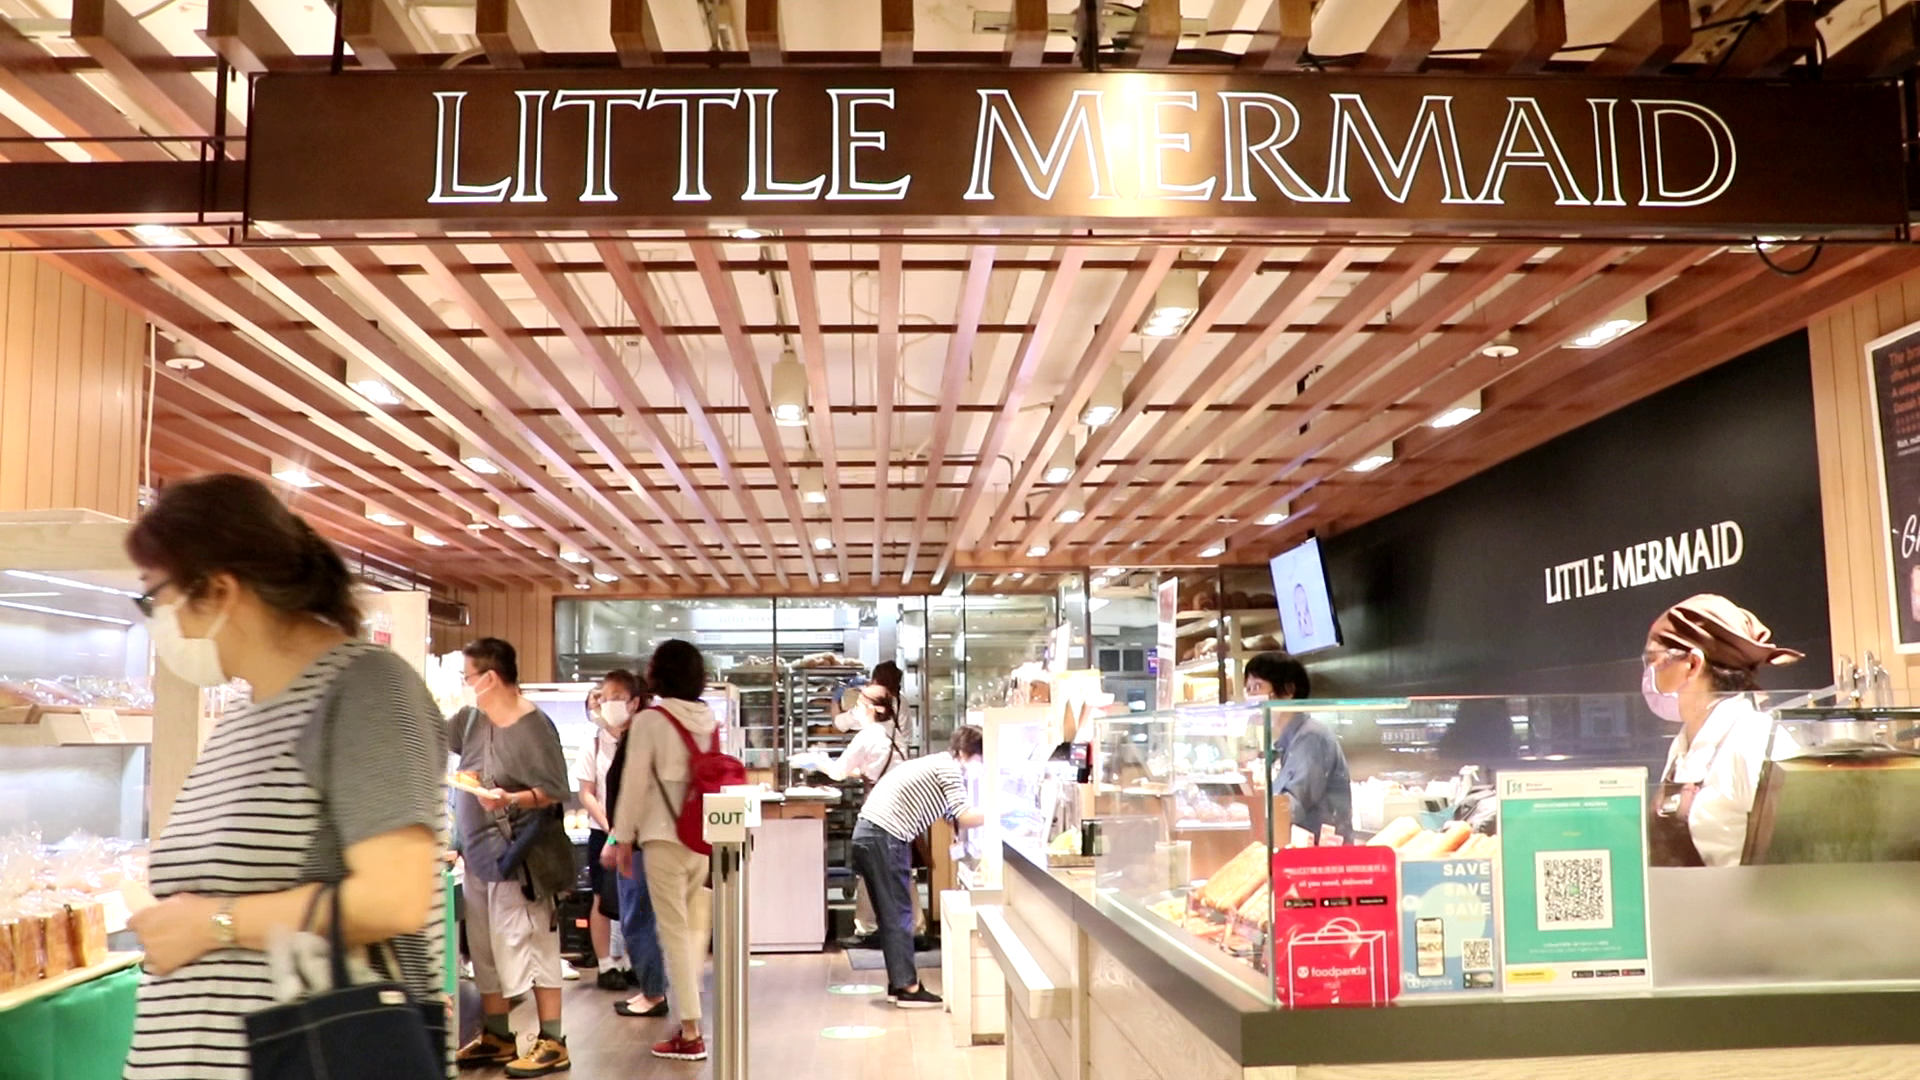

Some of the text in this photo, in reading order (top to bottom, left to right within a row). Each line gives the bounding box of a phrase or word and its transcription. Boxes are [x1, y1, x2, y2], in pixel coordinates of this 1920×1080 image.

[427, 88, 1737, 207] LITTLE MERMAID
[1544, 520, 1744, 604] LITTLE MERMAID
[708, 811, 743, 825] OUT
[1443, 862, 1490, 876] SAVE
[1444, 882, 1491, 896] SAVE
[1445, 902, 1492, 916] SAVE
[1311, 965, 1367, 979] foodpanda
